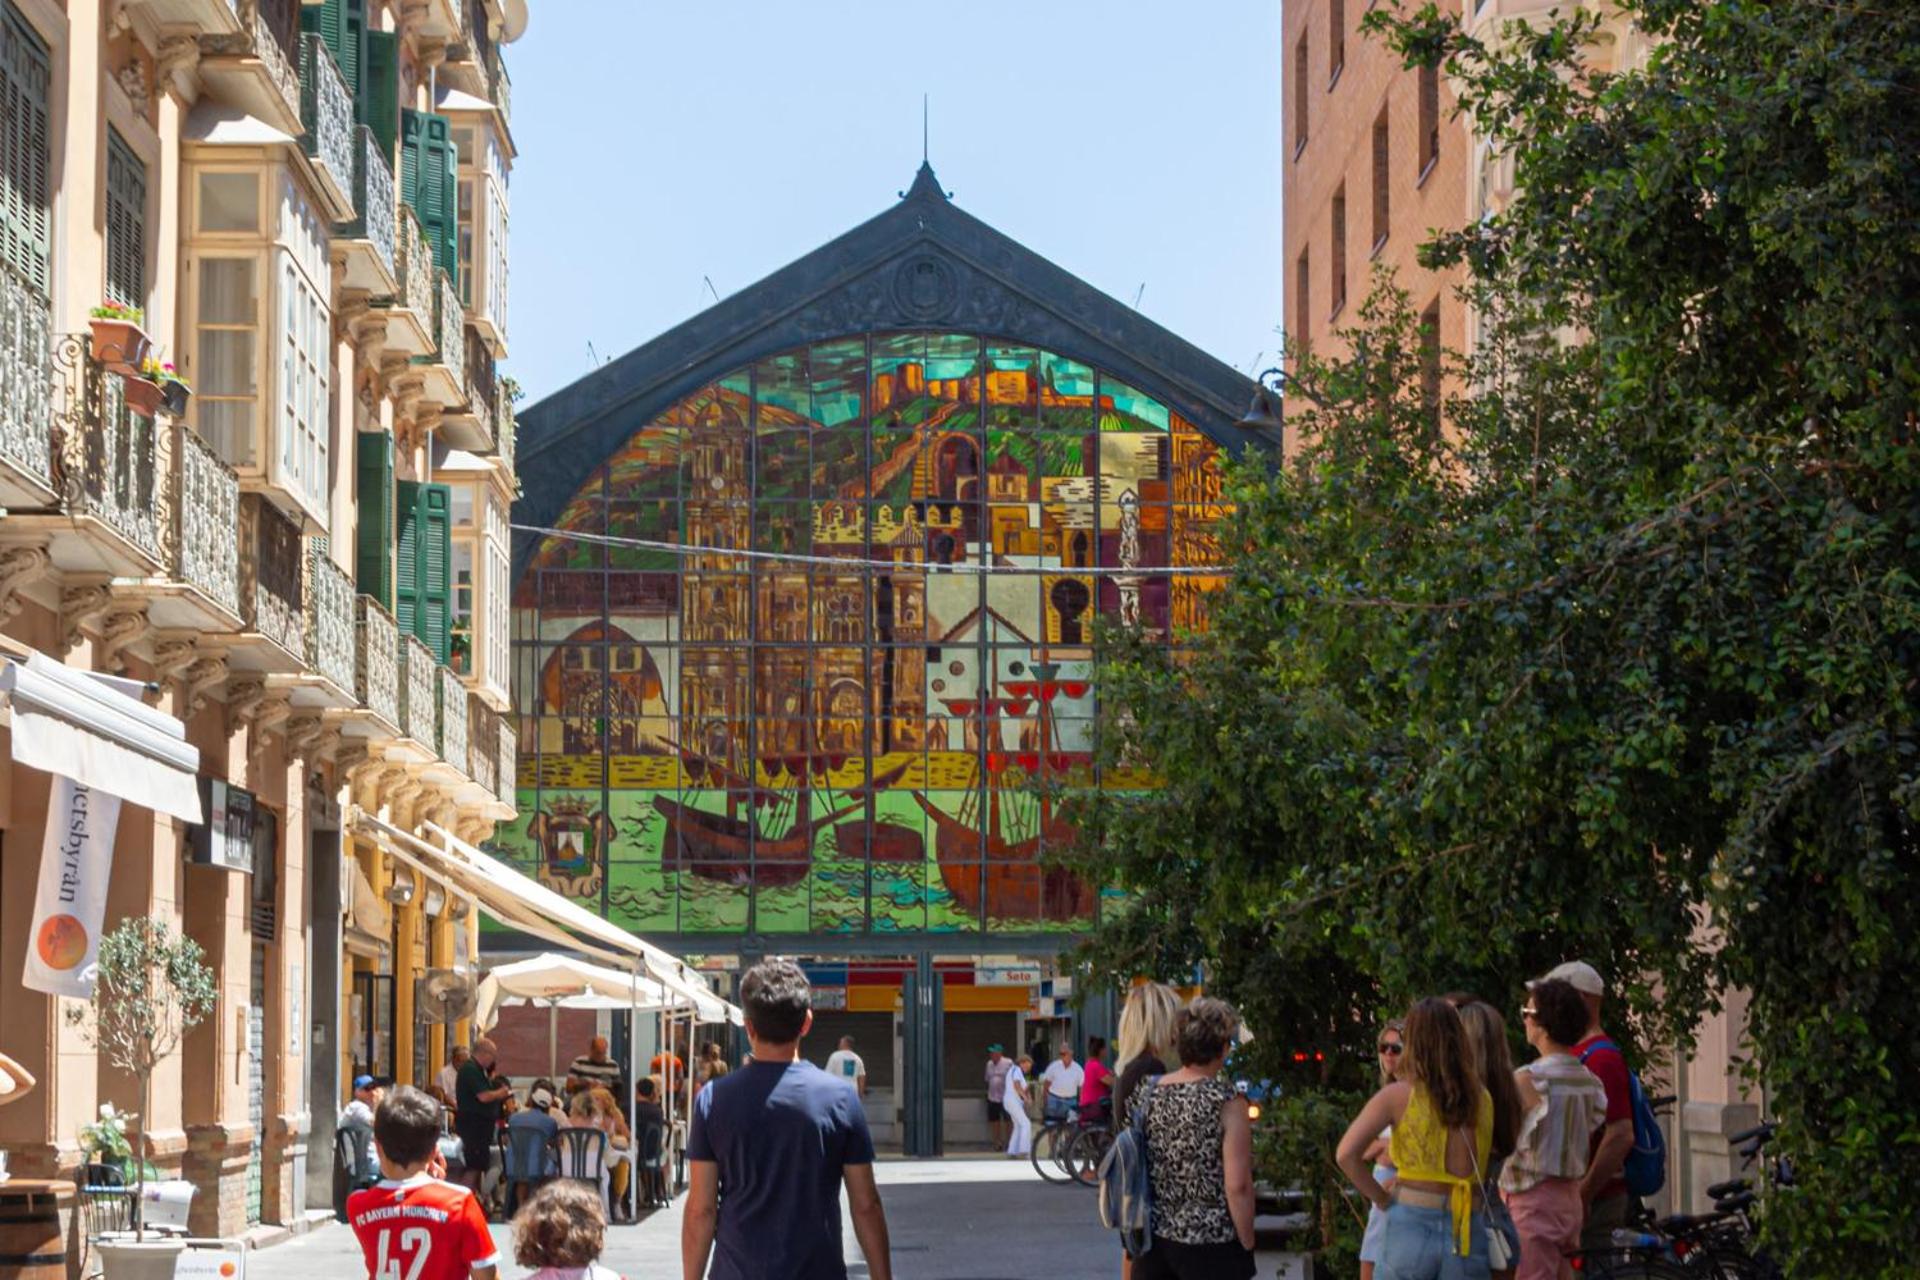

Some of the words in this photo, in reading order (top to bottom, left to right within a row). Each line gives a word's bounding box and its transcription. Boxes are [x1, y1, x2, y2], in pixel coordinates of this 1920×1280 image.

[356, 1213, 366, 1226] FC
[366, 1205, 400, 1223] BAYERN
[376, 1226, 431, 1280] 42
